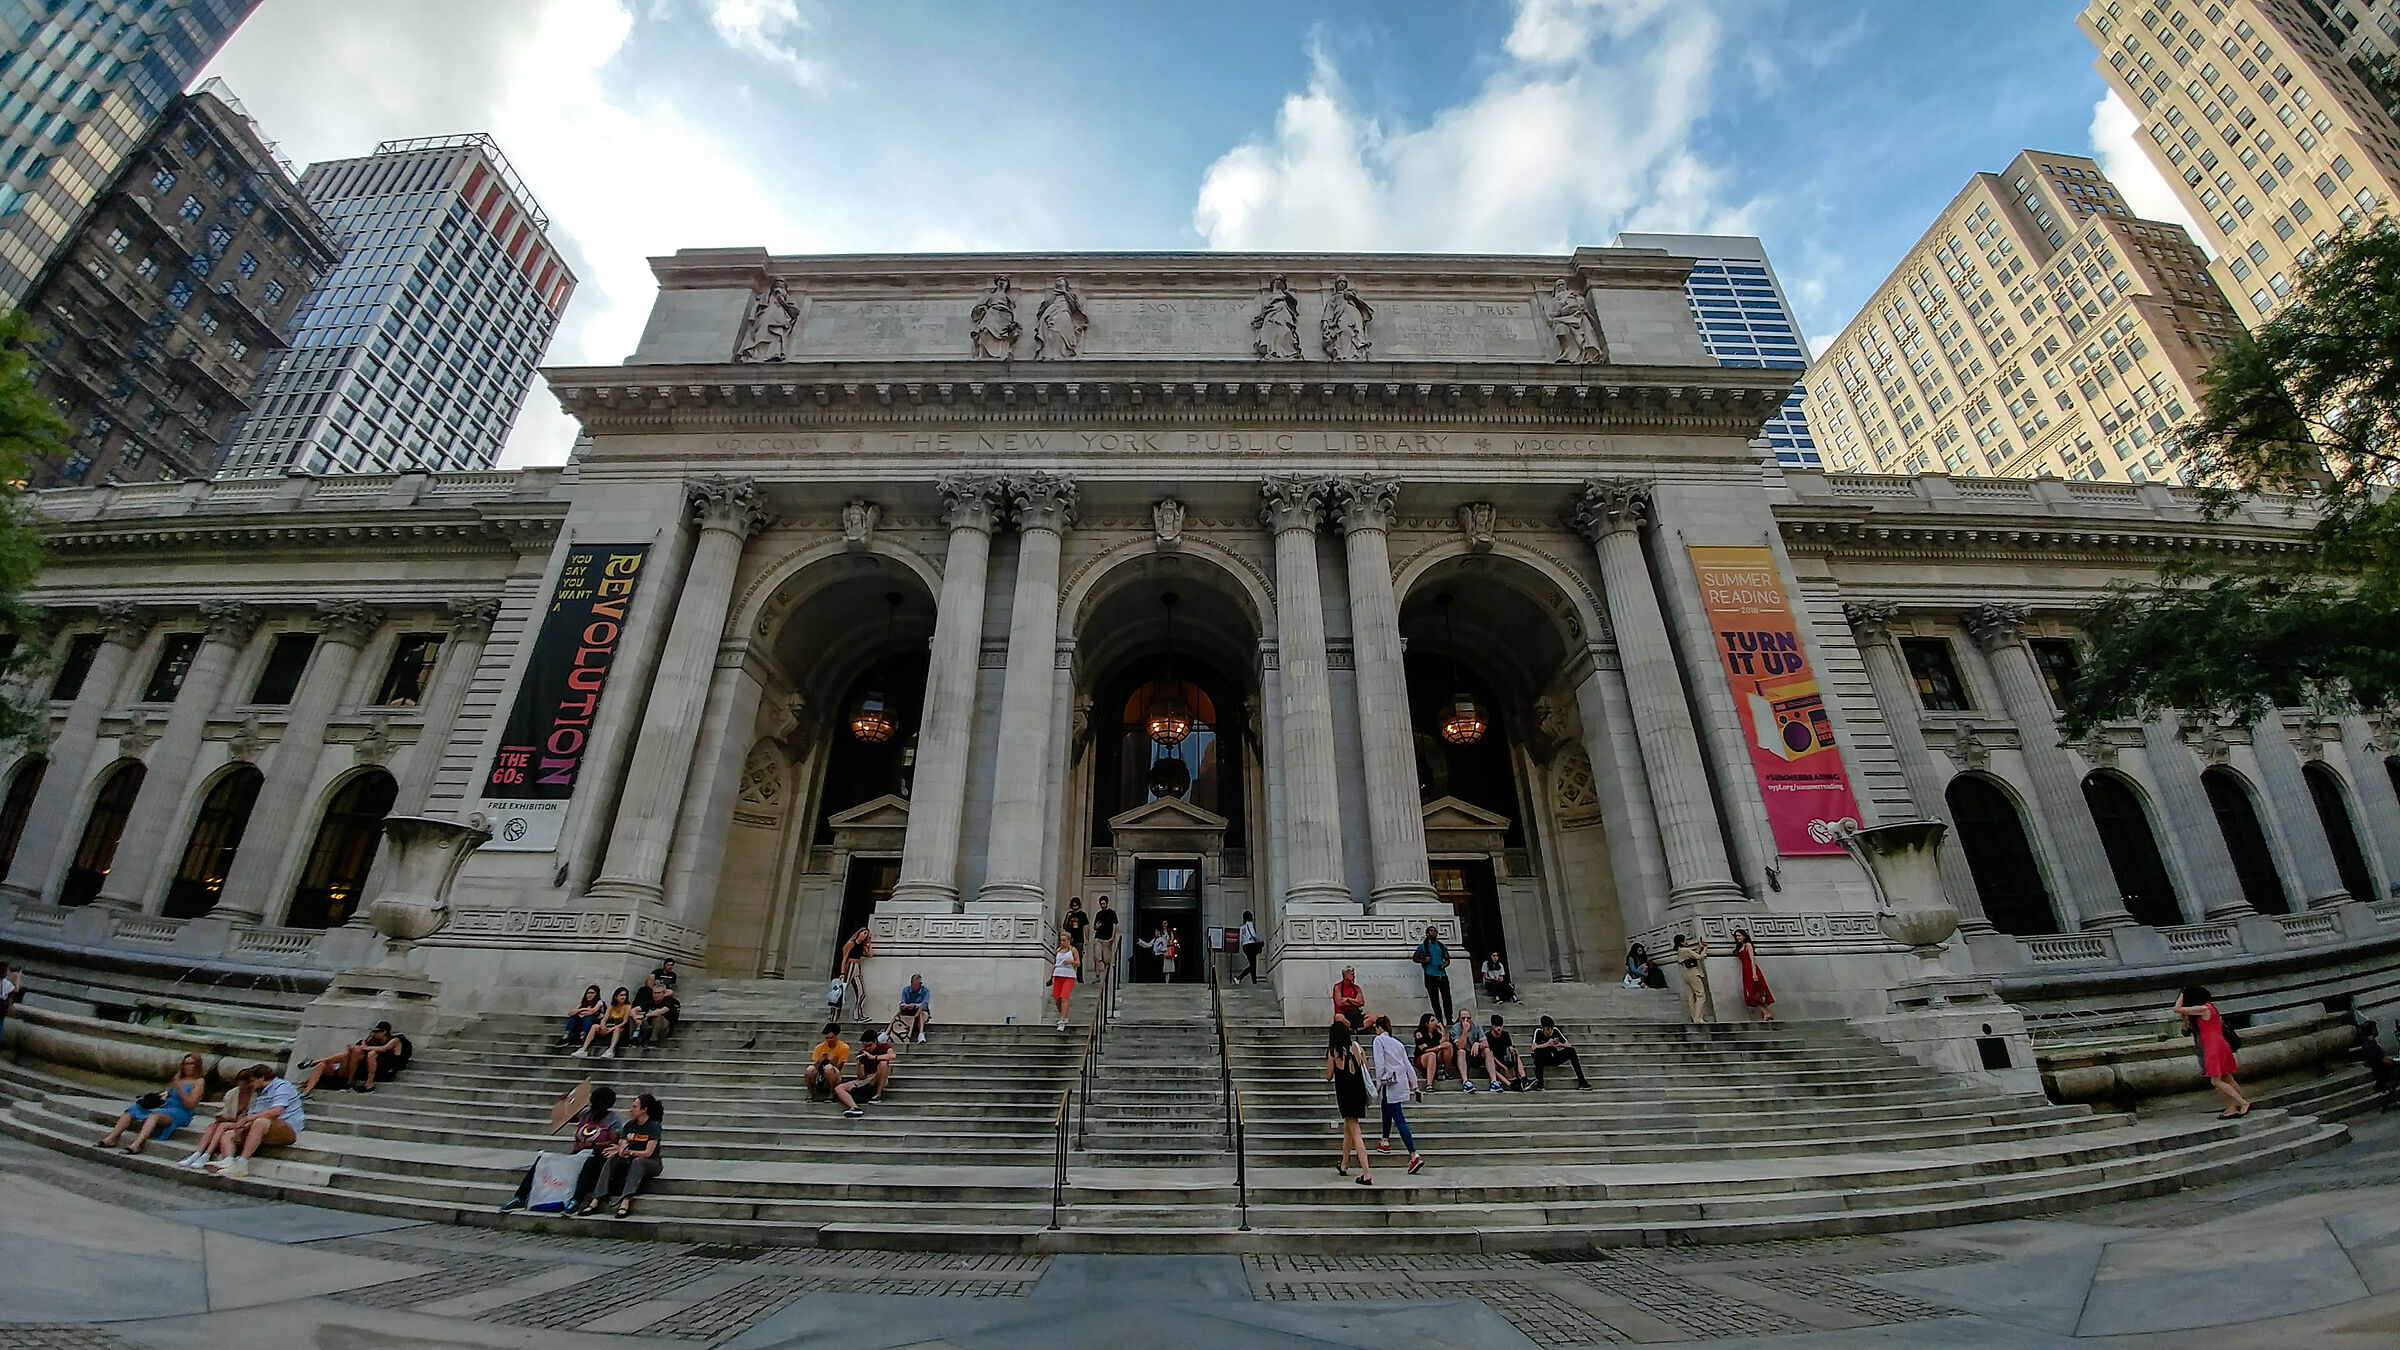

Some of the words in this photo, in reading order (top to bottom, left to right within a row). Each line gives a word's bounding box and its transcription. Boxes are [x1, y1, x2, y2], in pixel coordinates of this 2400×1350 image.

[820, 304, 846, 315] THE
[854, 304, 900, 315] ASTOR
[906, 303, 970, 314] LIBRARY
[1096, 303, 1122, 314] THE
[1130, 303, 1178, 314] LENOX
[1186, 303, 1246, 314] LIBRARY
[1373, 304, 1401, 315] THE
[1414, 304, 1465, 316] TILDEN
[1477, 305, 1520, 316] TRUST
[892, 434, 951, 450] THE
[977, 434, 1052, 450] NEW
[1081, 434, 1160, 452] YORK
[1187, 434, 1293, 451] PUBLIC
[1323, 434, 1449, 451] LIBRARY
[1514, 439, 1616, 451] MDCCCCII
[571, 554, 594, 564] YOU
[565, 567, 588, 576] SAY
[563, 578, 585, 588] YOU
[1704, 572, 1772, 587] SUMMER
[558, 590, 593, 600] WANT
[1709, 590, 1781, 605] READING
[552, 602, 561, 612] A
[1721, 631, 1798, 652] TURN
[535, 552, 643, 786] REVOLUTION
[1728, 652, 1755, 675] IT
[1763, 652, 1803, 675] UP
[500, 753, 531, 767] THE
[488, 802, 507, 810] FREE
[509, 803, 557, 811] EXHIBITION
